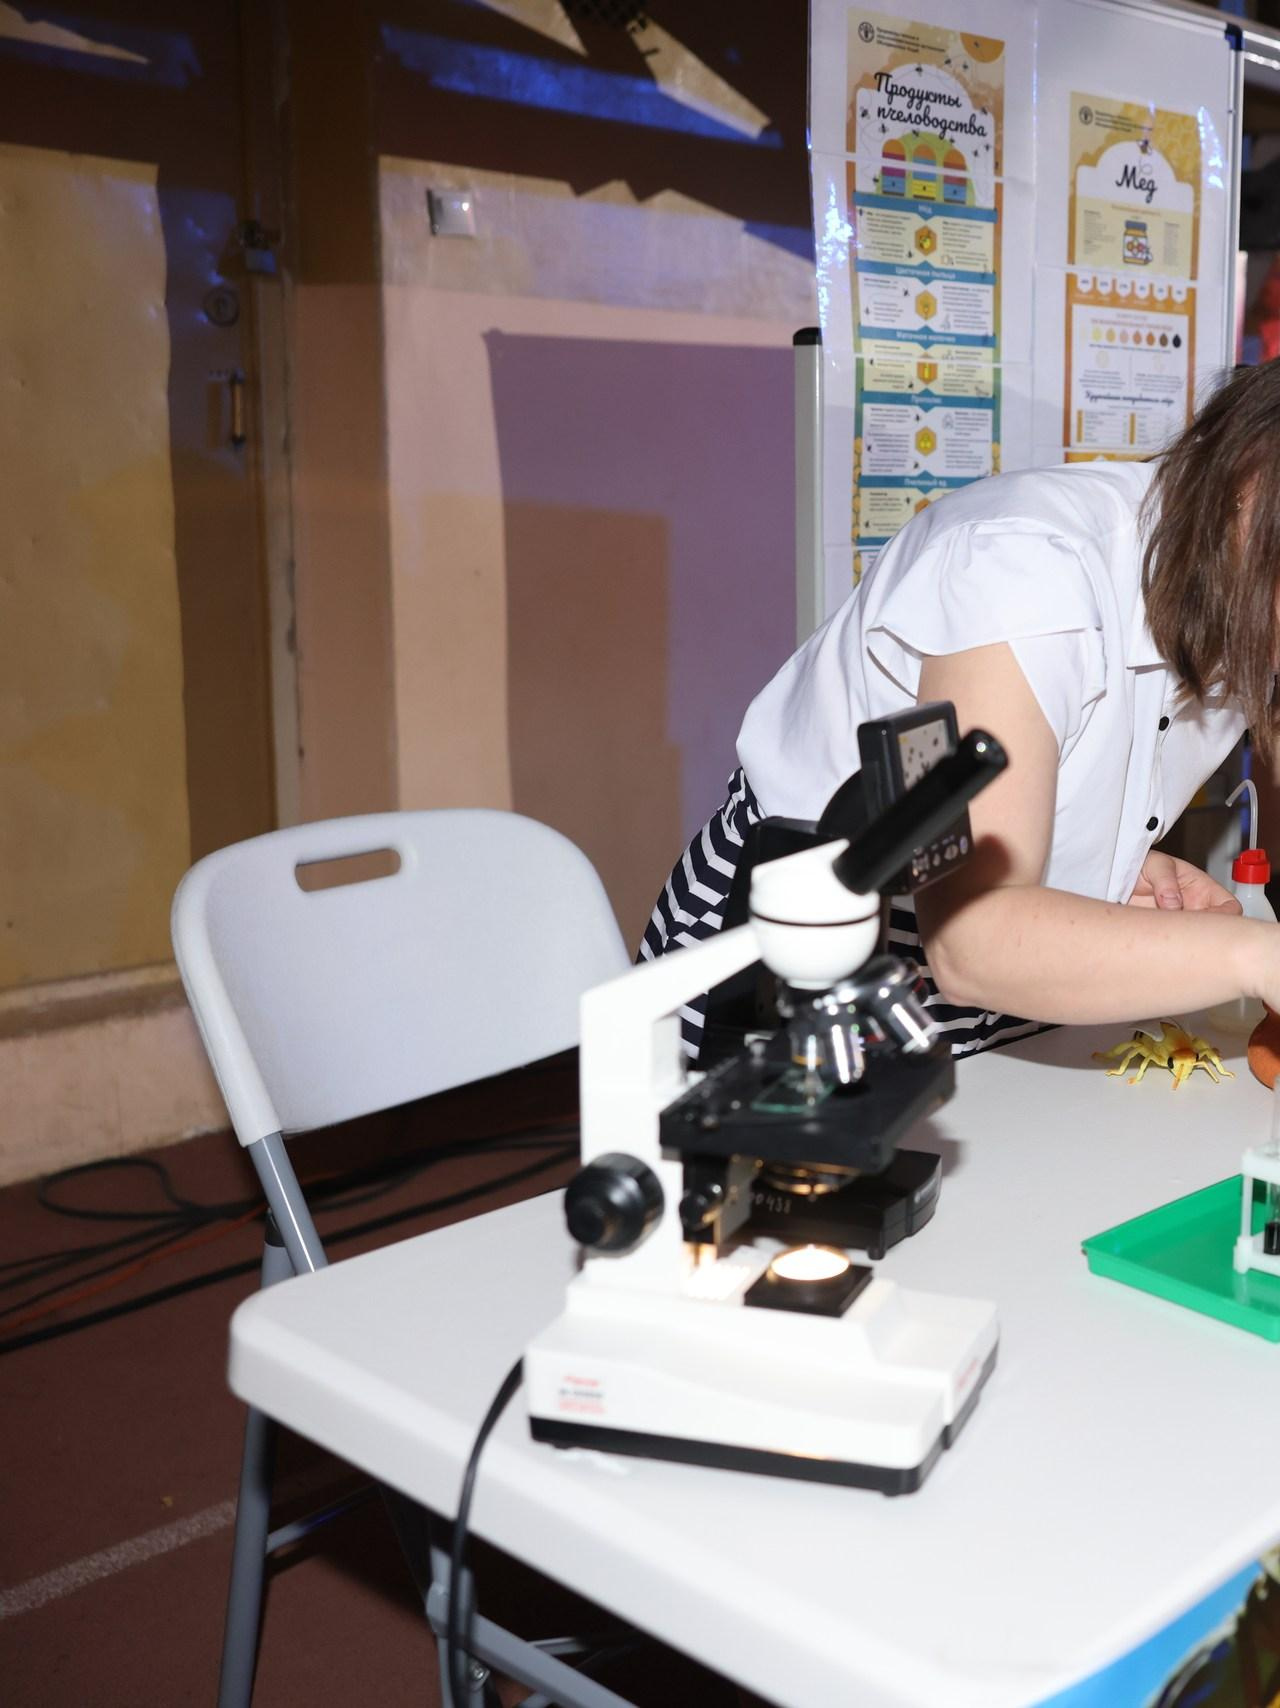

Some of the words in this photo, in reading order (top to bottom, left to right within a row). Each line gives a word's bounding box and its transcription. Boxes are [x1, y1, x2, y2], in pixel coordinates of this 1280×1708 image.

[874, 72, 962, 109] Продукты
[878, 103, 988, 140] пчеловодства
[1115, 164, 1158, 204] Мед
